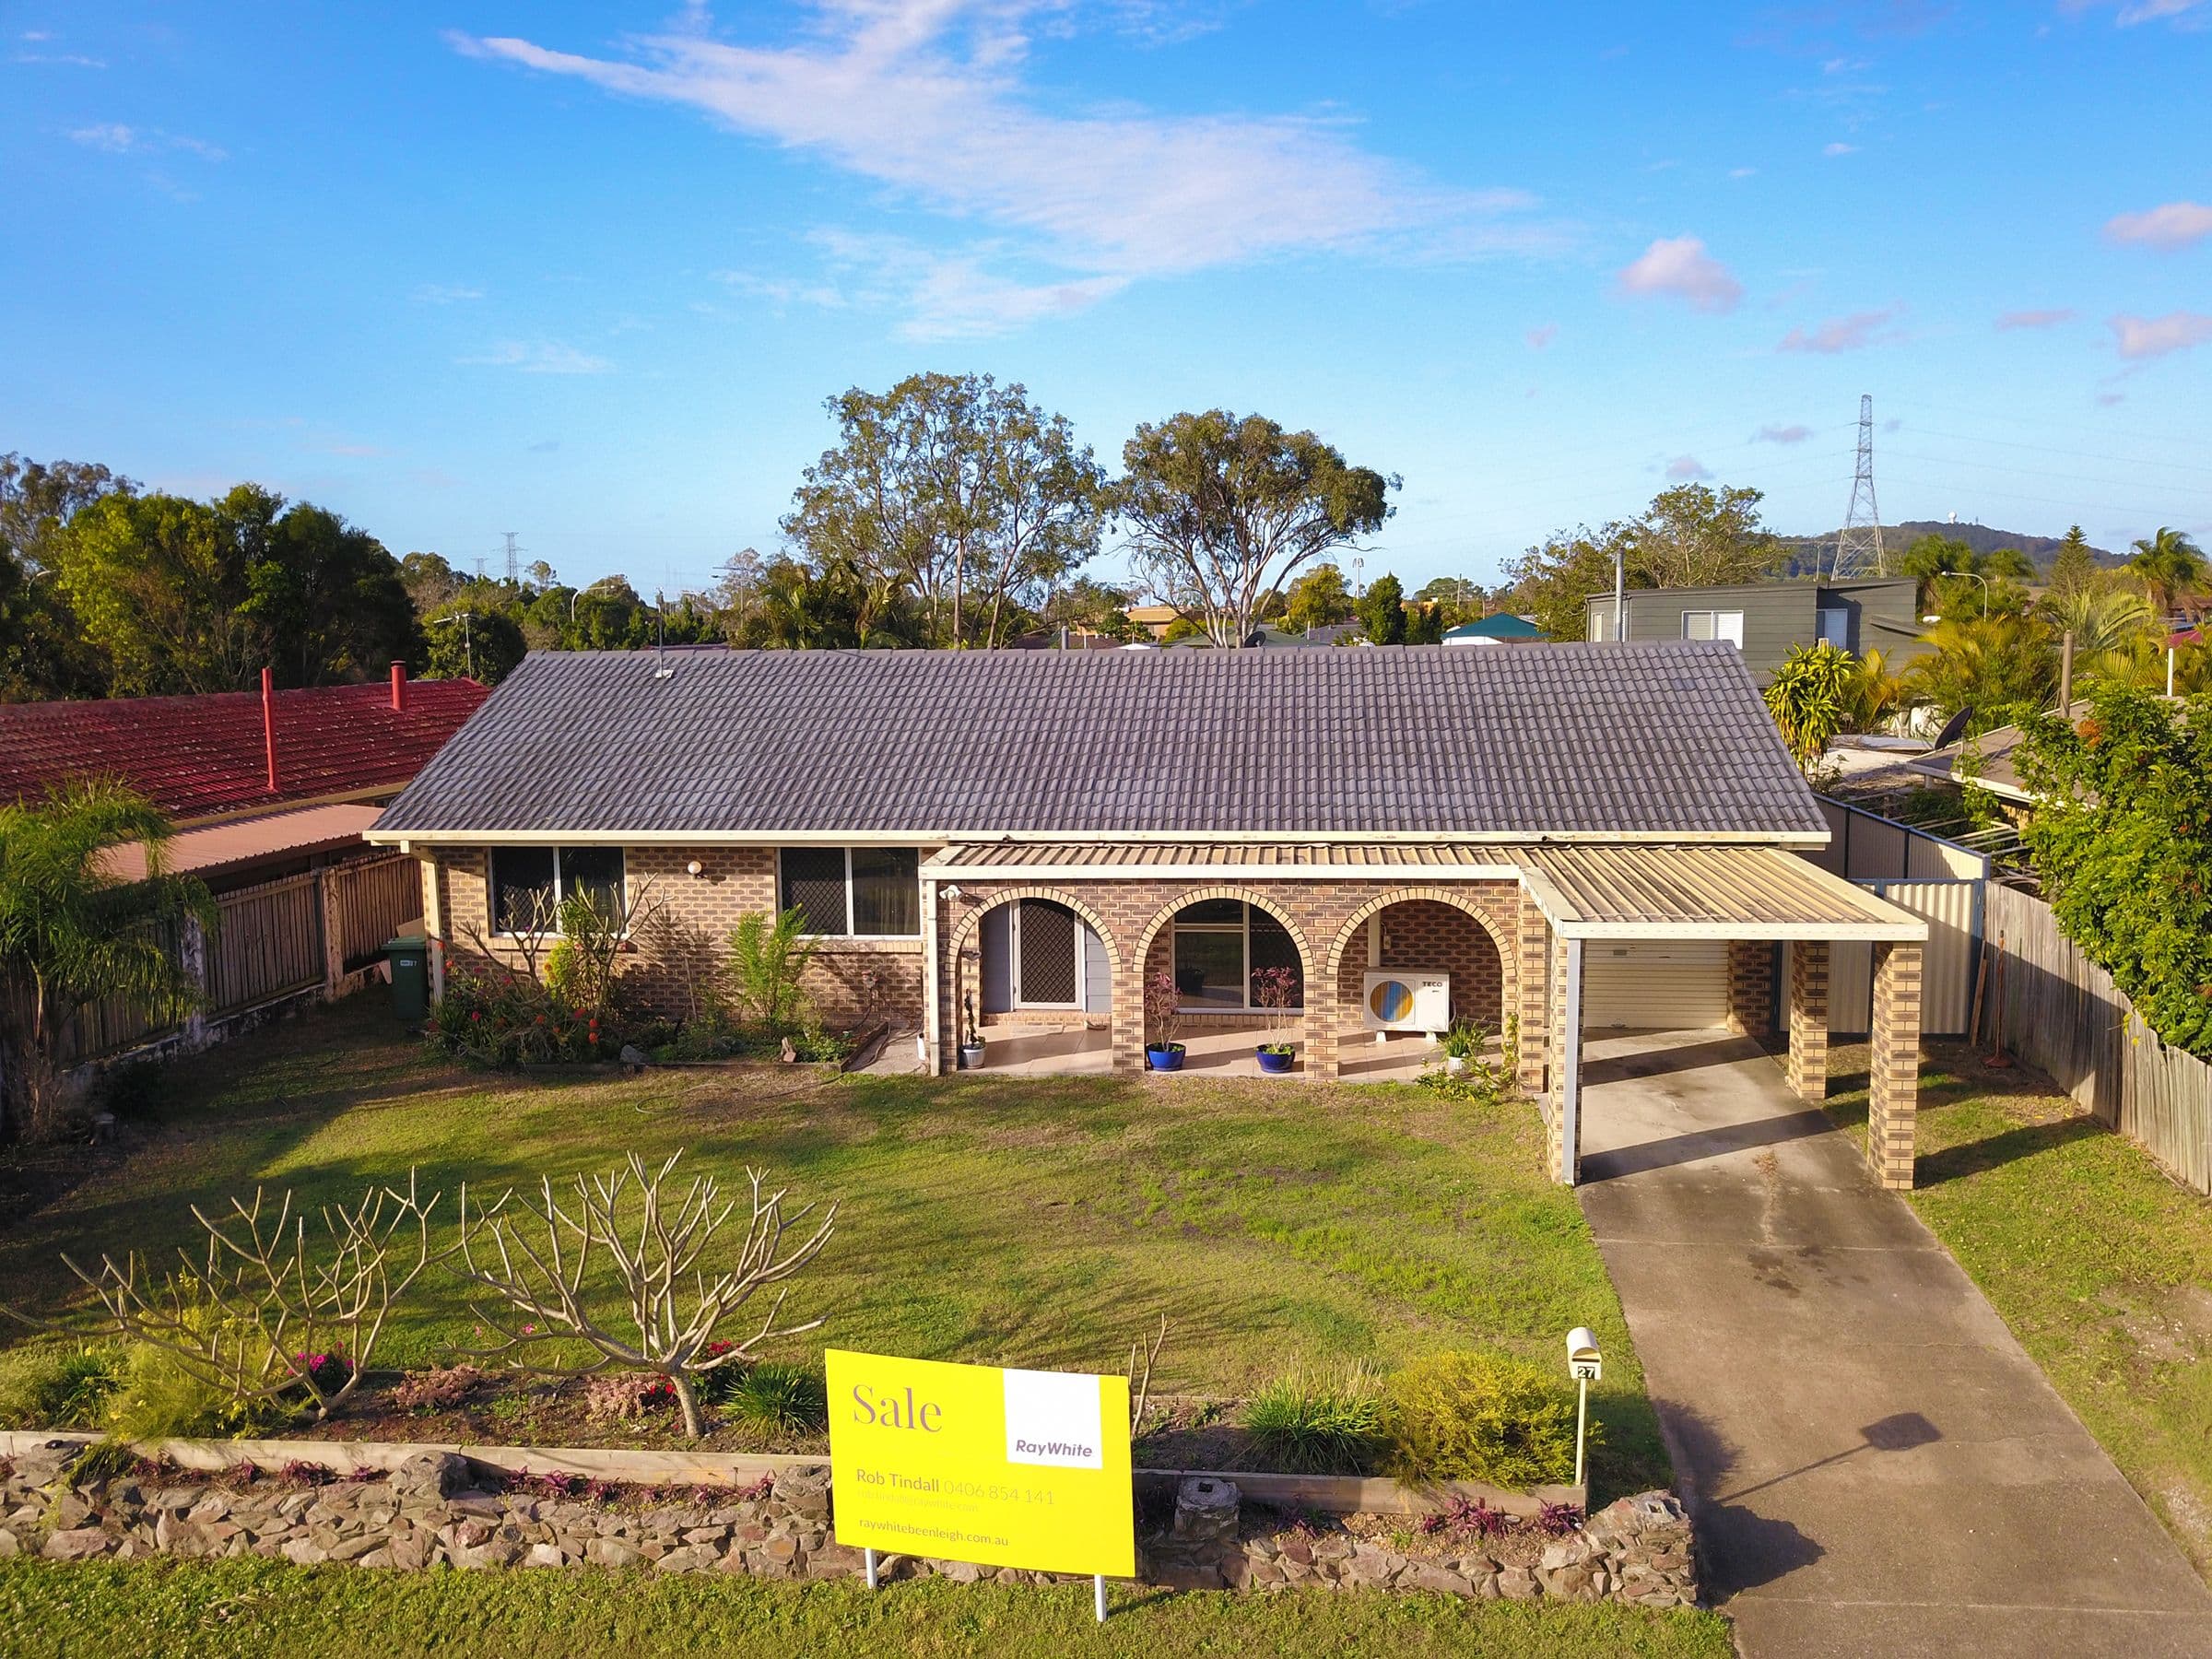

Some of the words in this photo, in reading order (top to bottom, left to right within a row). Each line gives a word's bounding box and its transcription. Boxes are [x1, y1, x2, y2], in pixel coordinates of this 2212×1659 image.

[1578, 1367, 1594, 1378] 27
[853, 1384, 943, 1433] Sale
[1016, 1439, 1093, 1458] RayWhite
[857, 1469, 885, 1485] Rob
[888, 1474, 939, 1492] Tindall
[944, 1481, 985, 1498] 0406
[989, 1485, 1019, 1501] 854
[1025, 1488, 1055, 1505] 141
[859, 1519, 1009, 1547] raywhitebeenleigh.com.au
